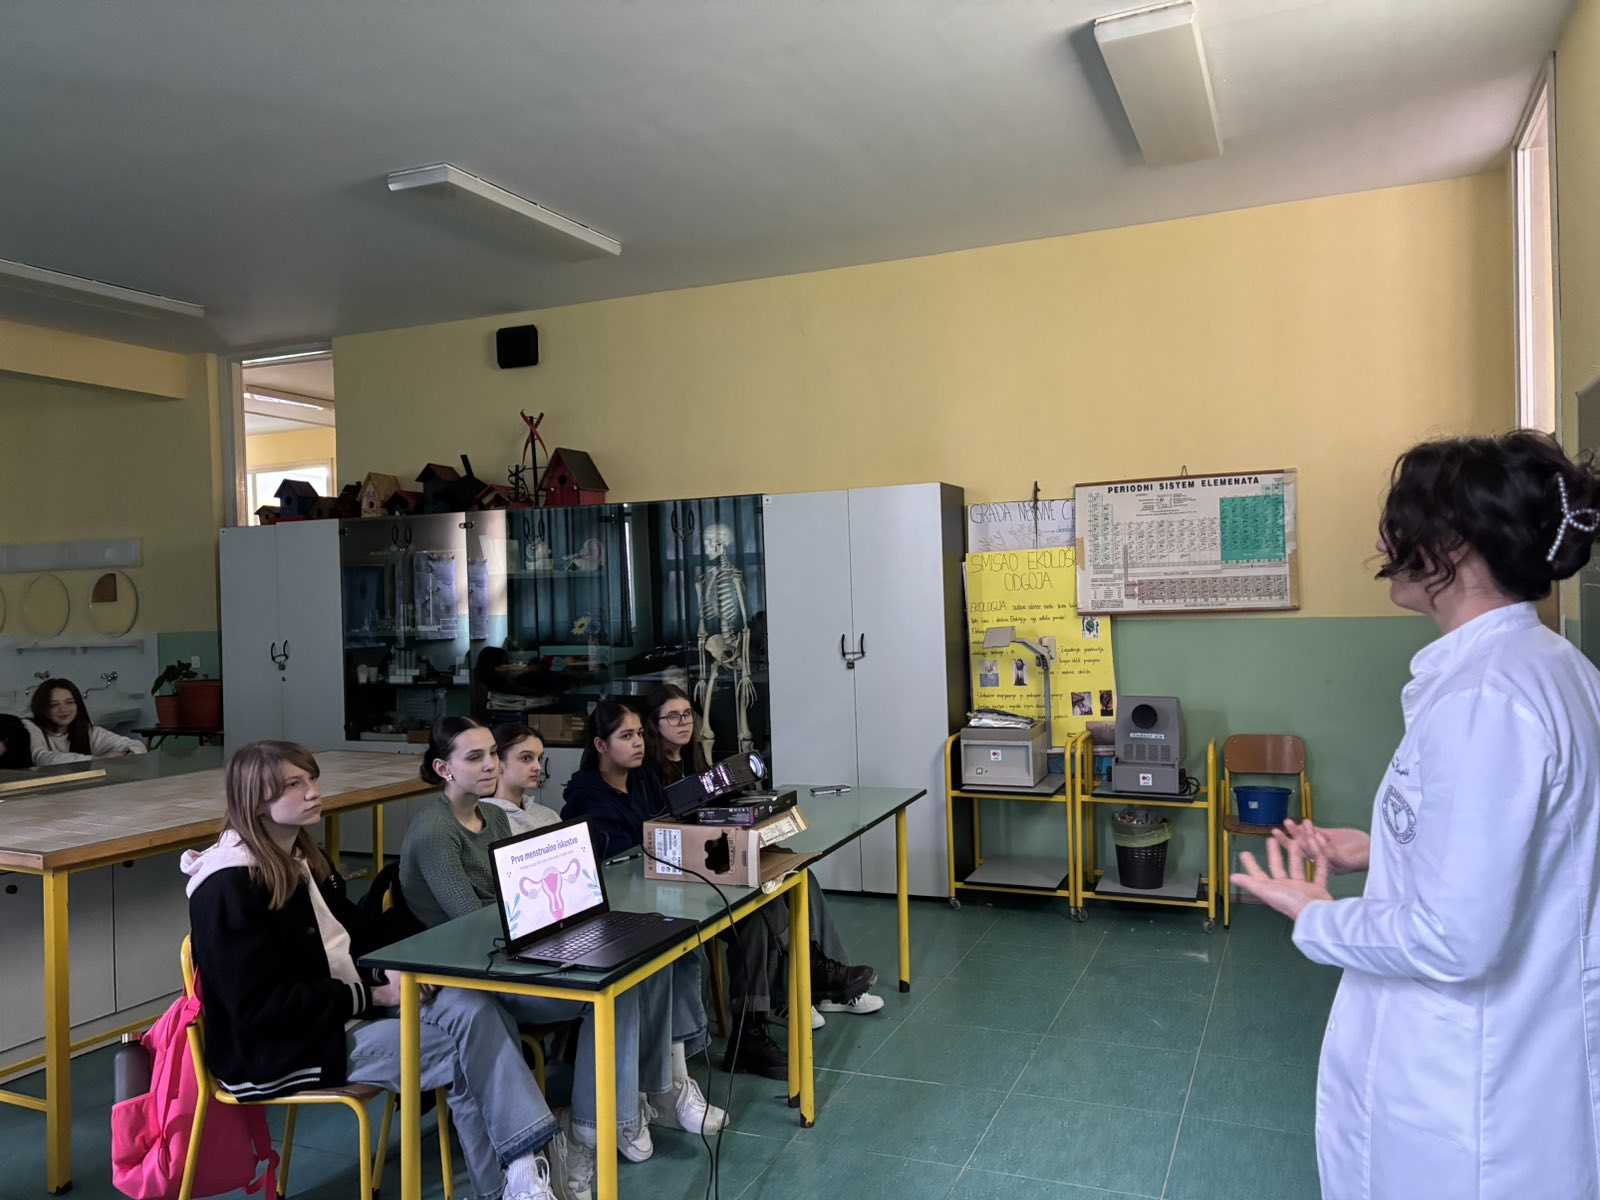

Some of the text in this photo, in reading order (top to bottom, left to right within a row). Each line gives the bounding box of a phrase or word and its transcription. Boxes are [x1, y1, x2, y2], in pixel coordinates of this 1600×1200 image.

[1107, 476, 1260, 494] PERIODNI SISTEM ELEMENATA
[969, 552, 1019, 574] SMISAO
[1003, 571, 1054, 592] ODGOJA
[510, 855, 525, 865] Prvo
[524, 843, 557, 861] menstrualno
[557, 836, 579, 850] iskustvo
